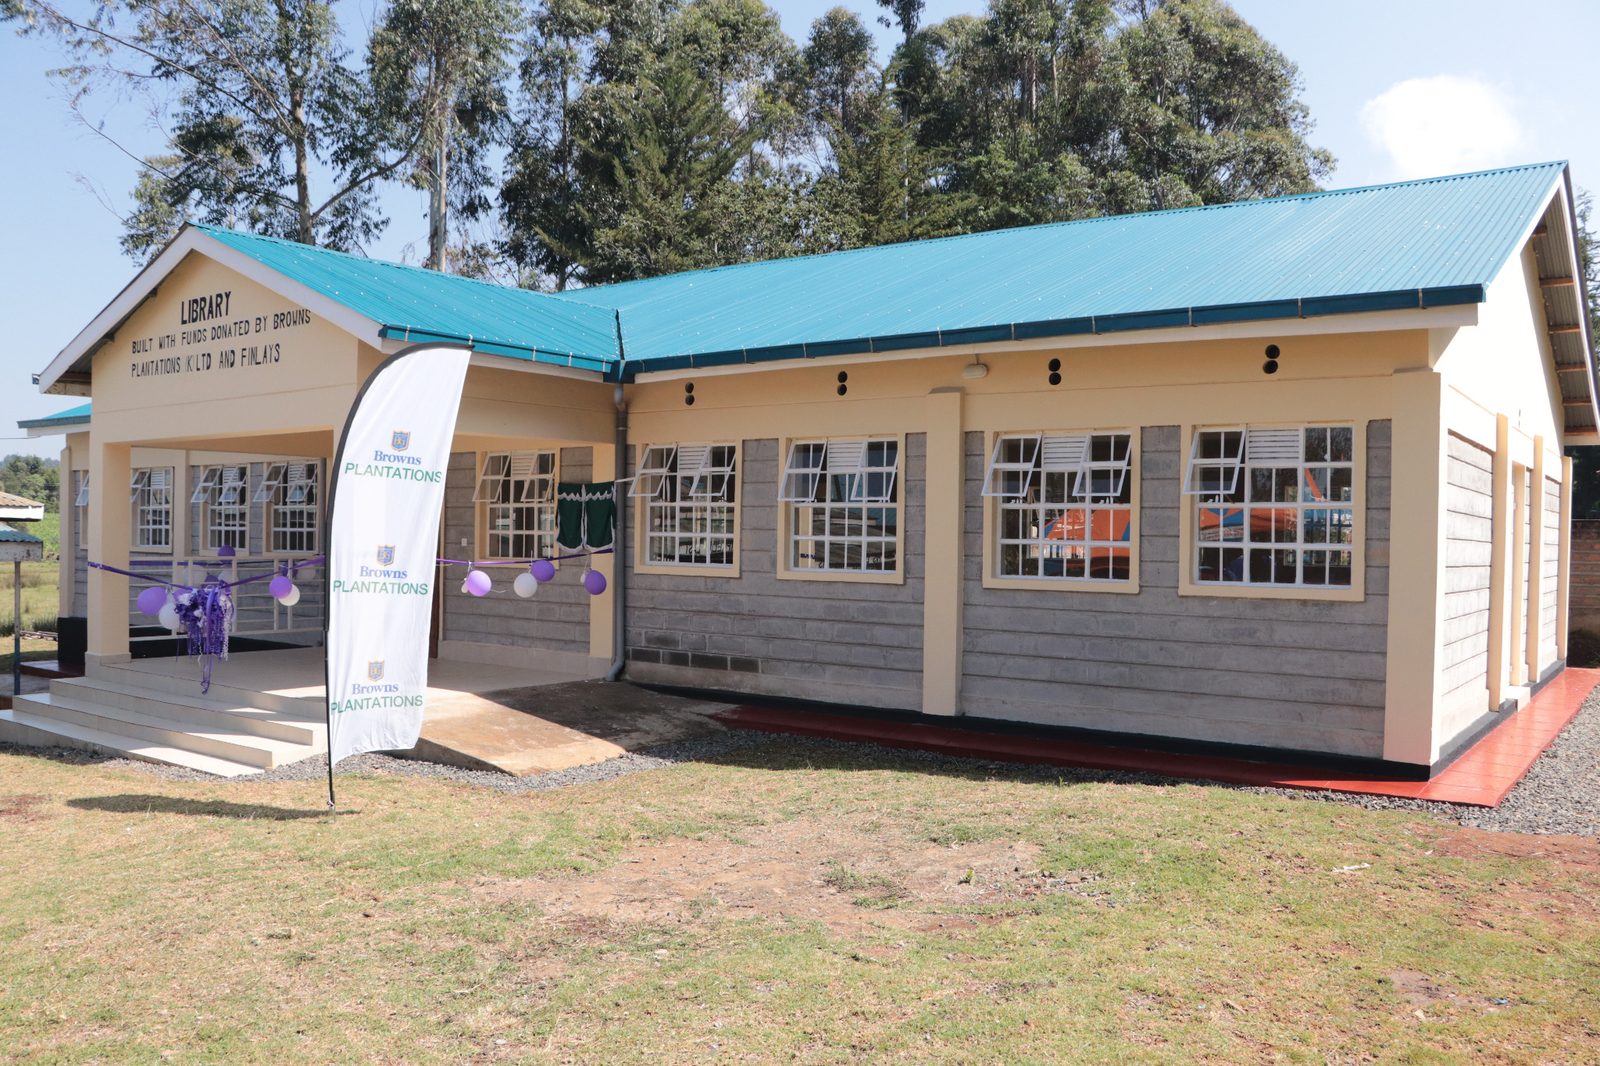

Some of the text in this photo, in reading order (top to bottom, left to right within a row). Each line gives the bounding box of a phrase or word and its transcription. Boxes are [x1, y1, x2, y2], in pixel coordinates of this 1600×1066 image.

[180, 291, 232, 325] LIBRARY
[131, 308, 312, 354] BUILT WITH FUNDS DONATED BY BROWNS
[131, 357, 181, 377] PLANTATIONS
[218, 350, 235, 369] AND
[240, 343, 281, 367] FINLAYS
[373, 450, 422, 466] Browns
[344, 462, 442, 483] PLANTATIONS
[359, 565, 408, 579] Browns
[332, 579, 429, 596] PLANTATIONS
[351, 683, 400, 695] Browns
[330, 694, 423, 716] PLANTATIONS
